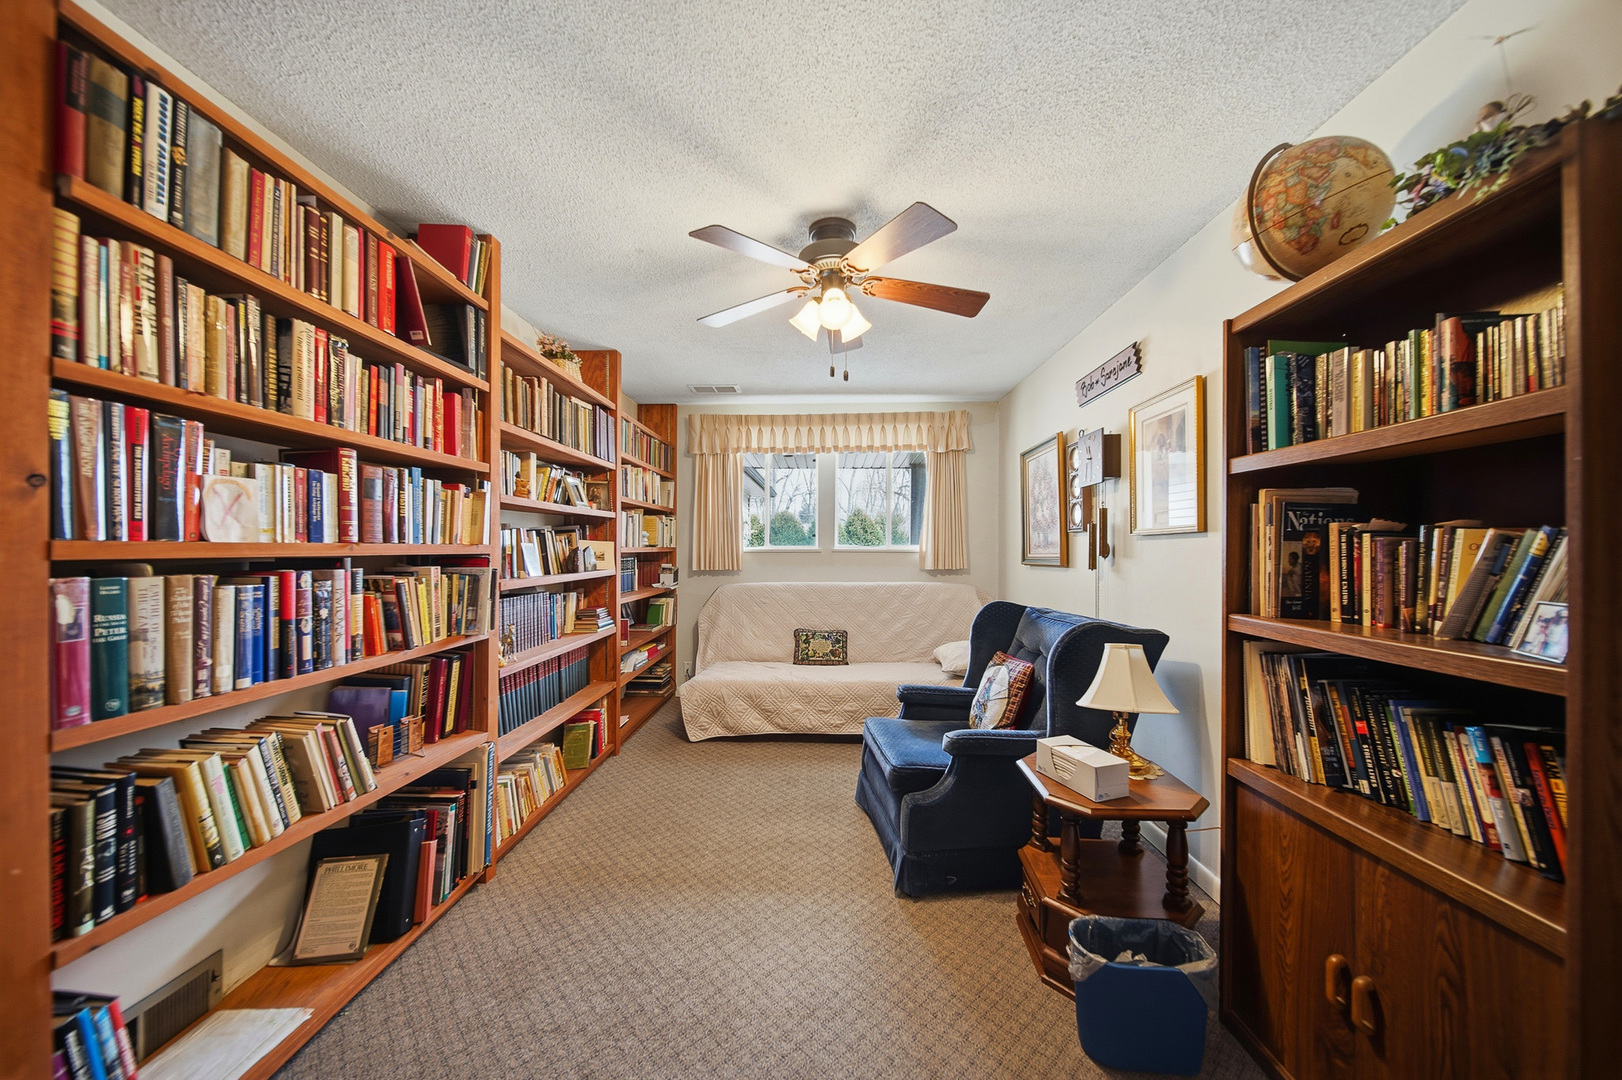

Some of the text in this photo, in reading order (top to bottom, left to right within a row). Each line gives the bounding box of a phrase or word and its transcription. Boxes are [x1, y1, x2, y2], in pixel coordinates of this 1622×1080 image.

[156, 143, 167, 205] FAREWELL
[267, 346, 276, 401] STALINGRAD
[156, 431, 174, 491] Archipelago
[136, 587, 149, 603] THE
[148, 582, 161, 620] EMPIRE
[94, 626, 127, 637] PETER
[1362, 744, 1378, 788] STOLEN LIVES
